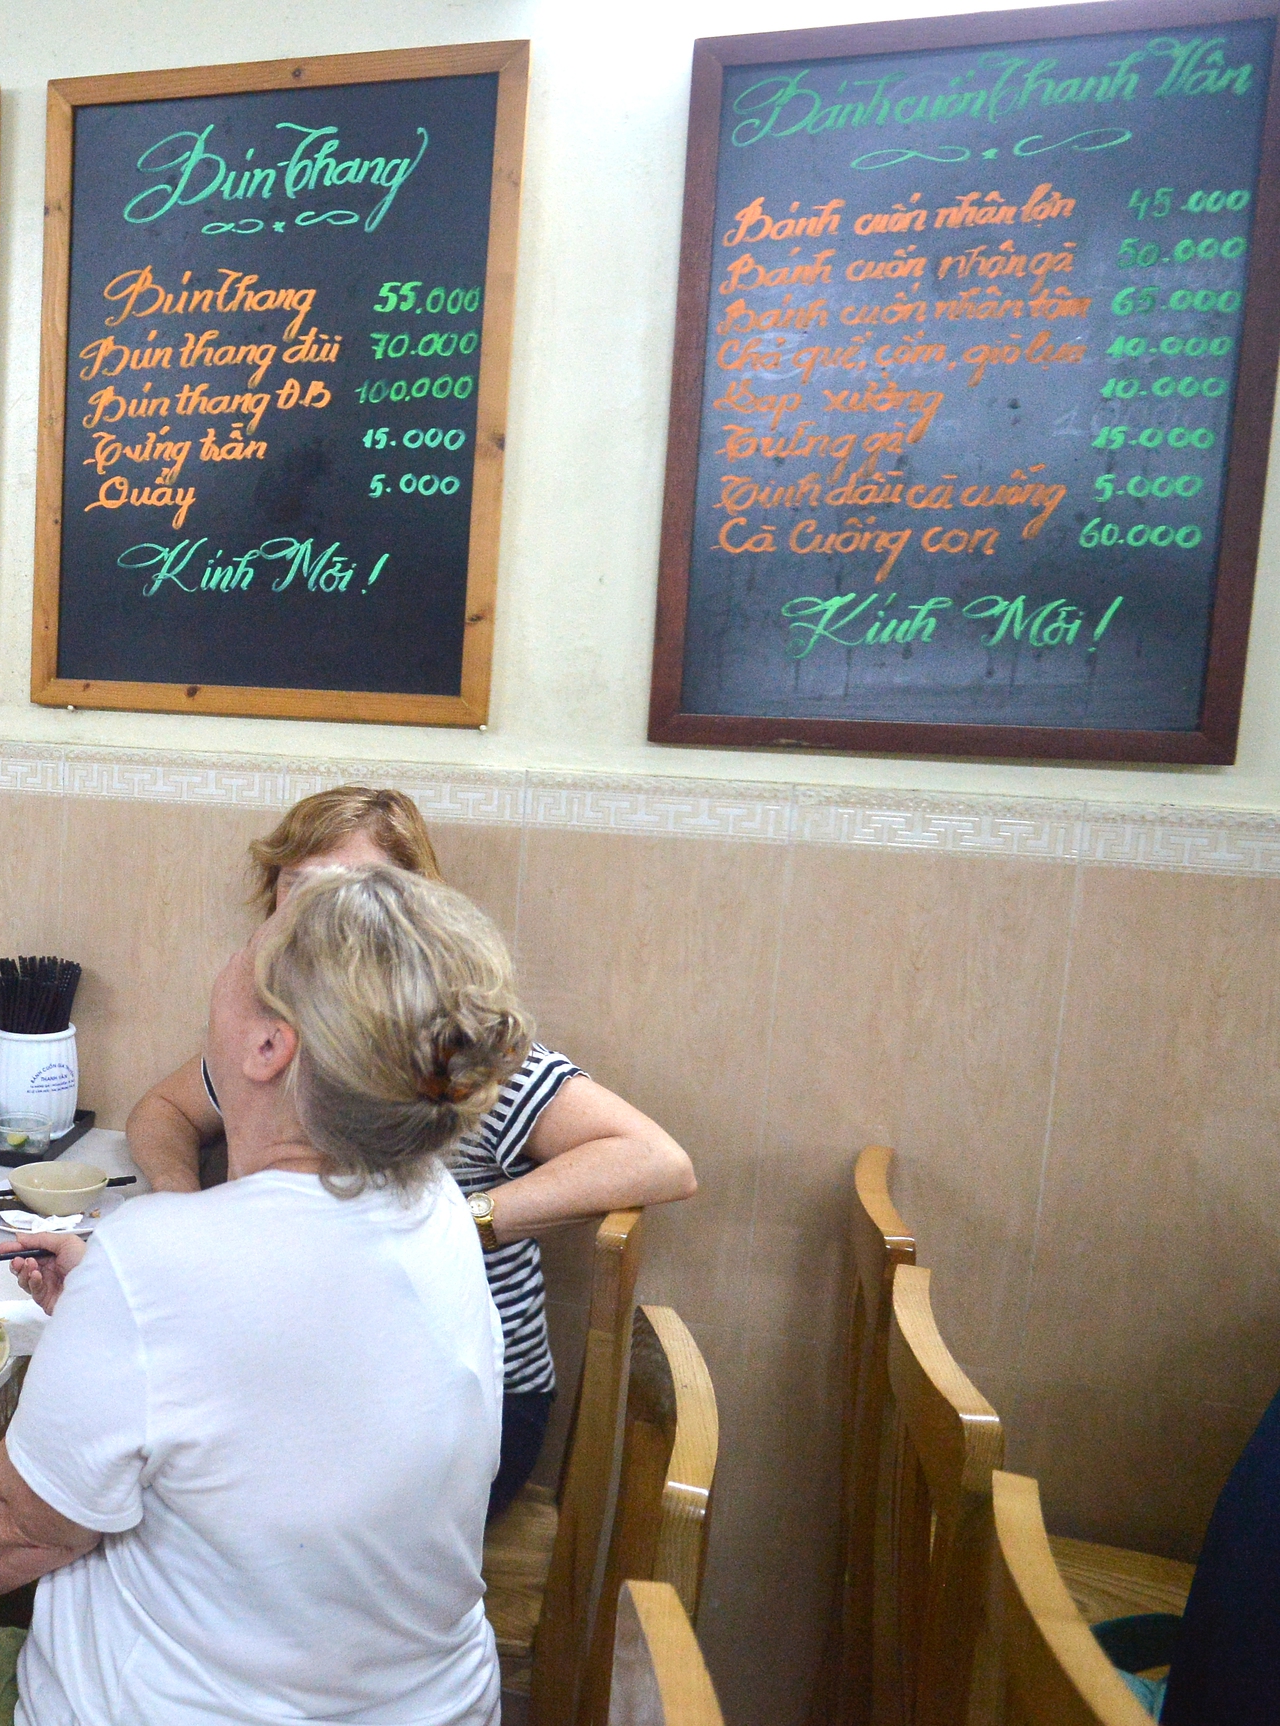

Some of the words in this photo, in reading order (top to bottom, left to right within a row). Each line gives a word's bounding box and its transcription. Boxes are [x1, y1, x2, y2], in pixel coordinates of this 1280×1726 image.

[721, 196, 846, 248] Bánh
[854, 192, 928, 236] cuốn
[933, 190, 1020, 229] nhân
[1126, 186, 1253, 221] 45.000
[718, 246, 837, 296] Bánh
[844, 244, 928, 283] cuốn
[935, 239, 1027, 281] nhân
[1116, 235, 1249, 270] 50.000
[372, 280, 481, 315] 55.000
[715, 293, 831, 336] Bánh
[838, 282, 929, 326] cuốn
[1110, 285, 1244, 317] 65.000
[77, 329, 173, 382] Bún
[179, 328, 278, 390] thang
[369, 329, 479, 361] 70.000
[353, 373, 476, 404] 100.000
[1099, 375, 1230, 400] 10.000
[81, 381, 171, 430] Bún
[175, 382, 272, 436] thang
[361, 426, 467, 452] 15.000
[1090, 425, 1217, 450] 15.000
[368, 472, 462, 499] 5.000
[905, 473, 960, 511] cà
[1091, 473, 1206, 503] 5.000
[710, 516, 779, 556] Cà
[920, 525, 1002, 557] con
[1078, 516, 1204, 550] 60.000
